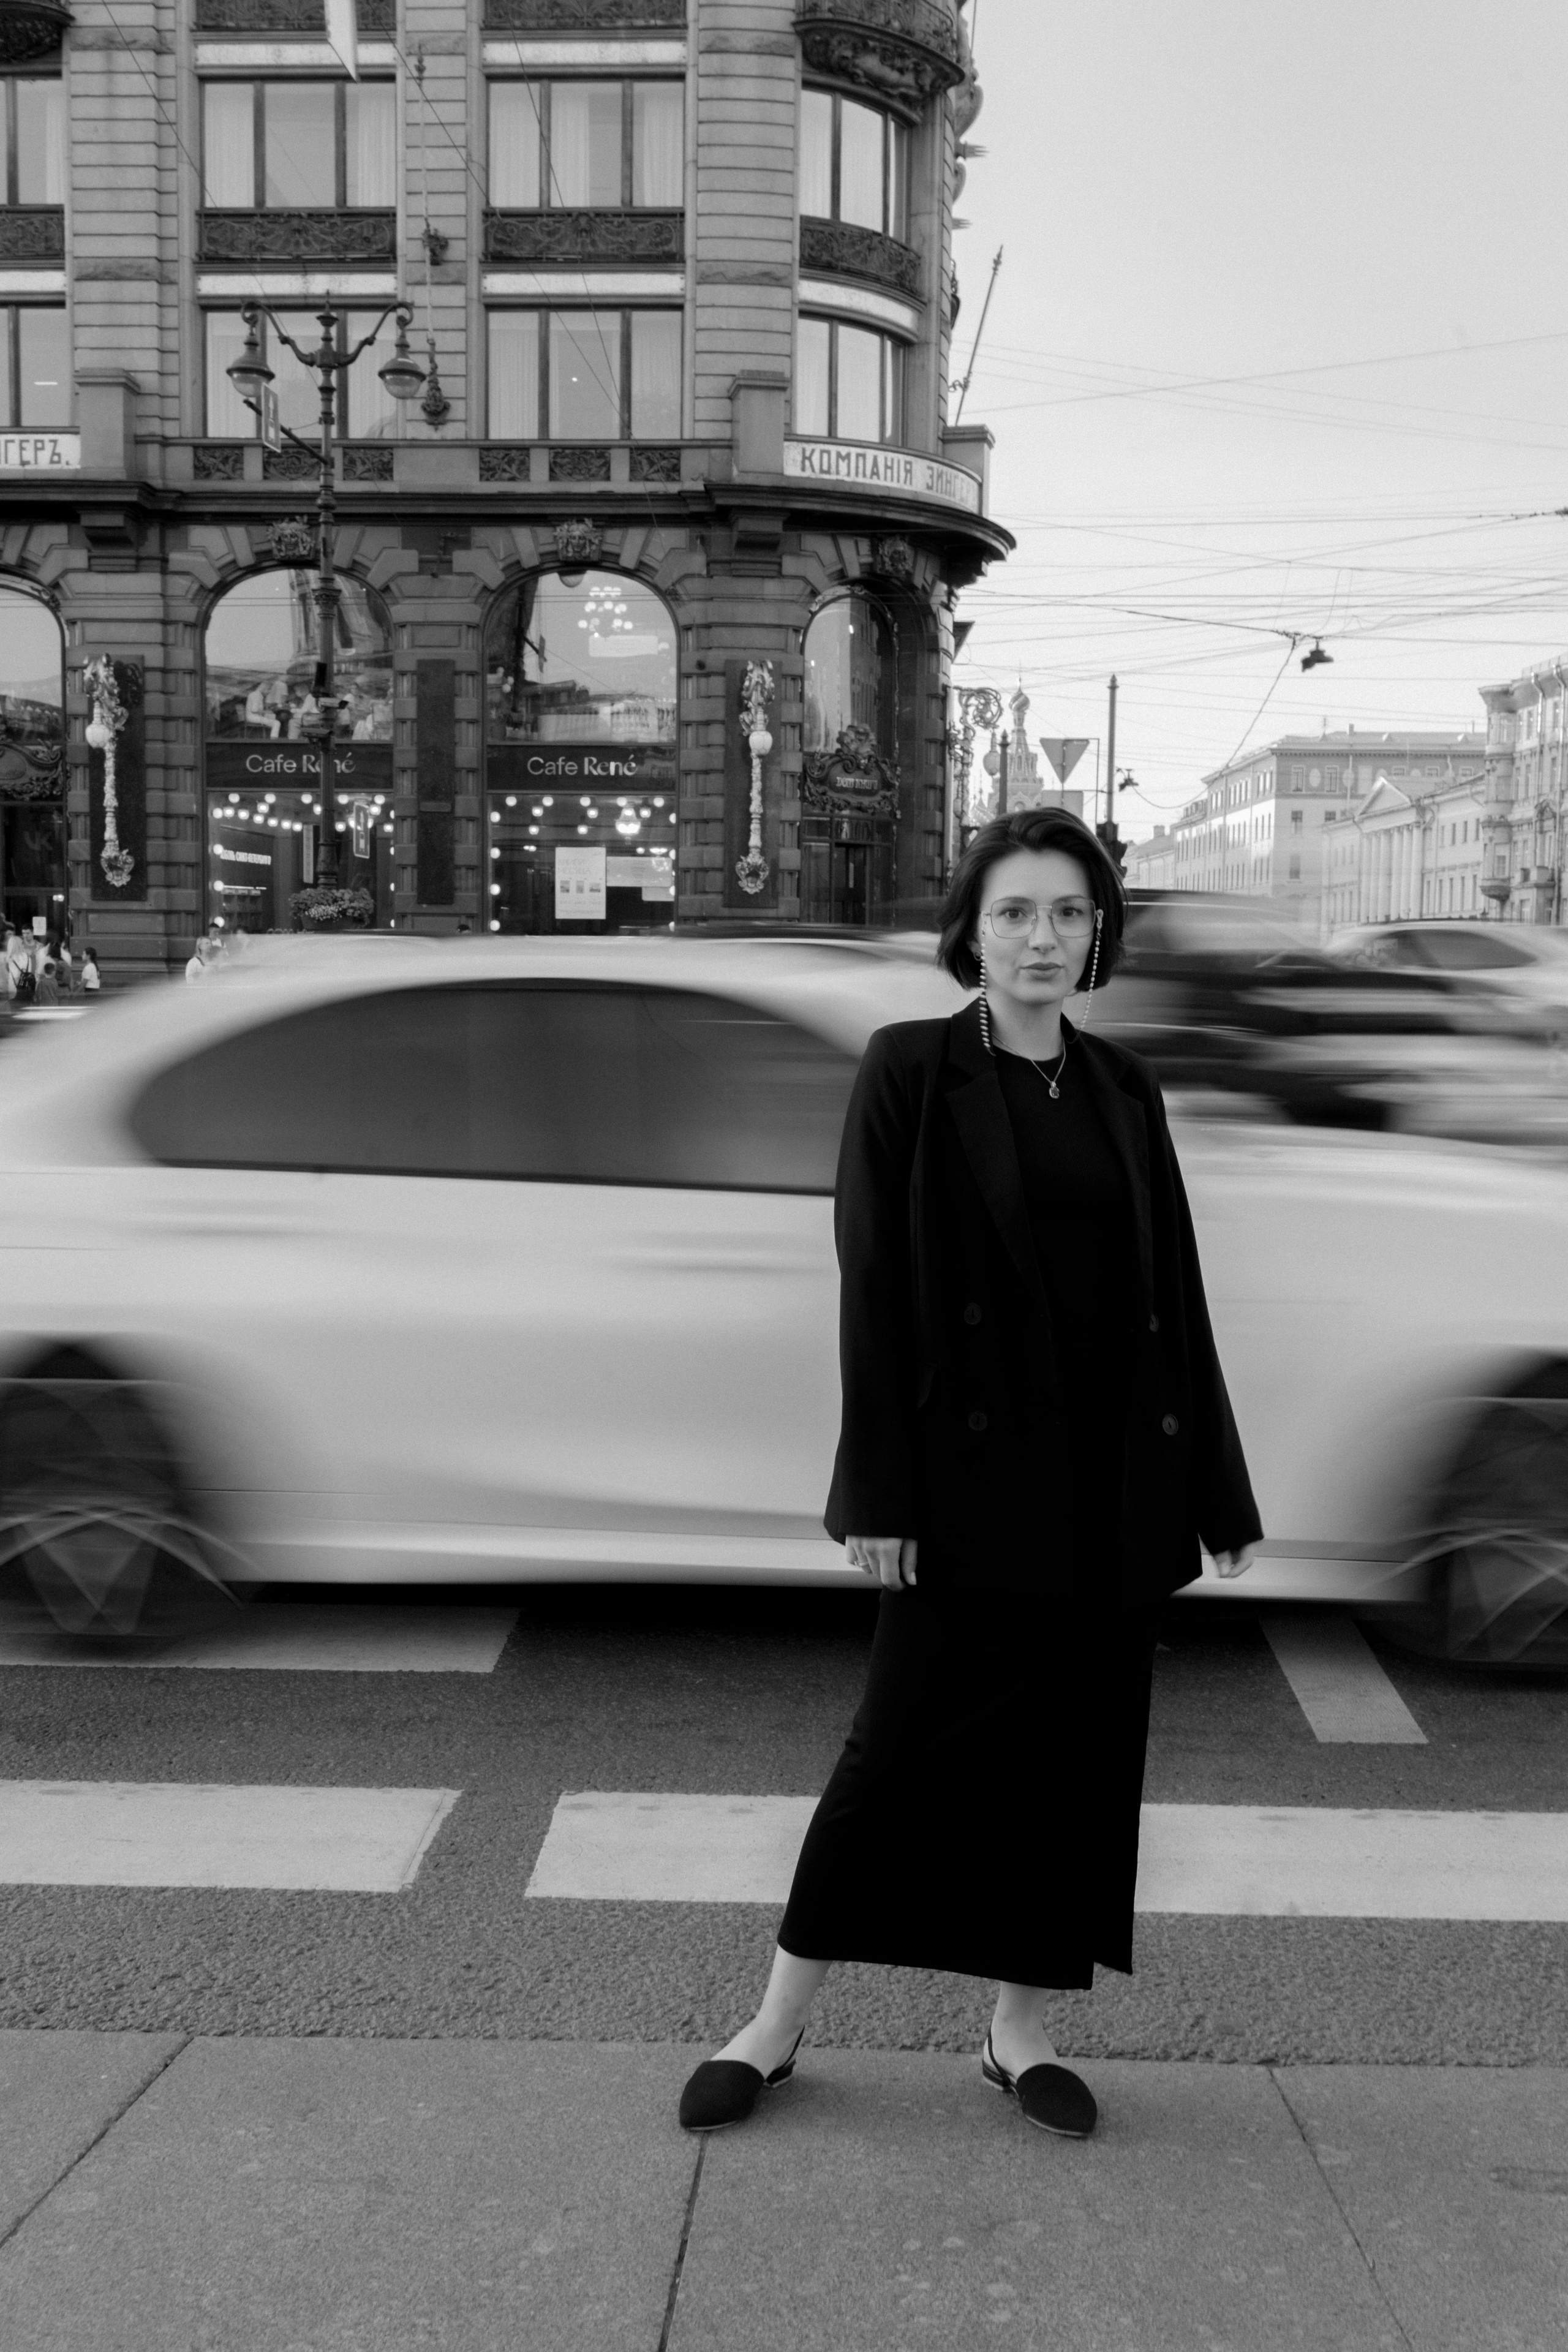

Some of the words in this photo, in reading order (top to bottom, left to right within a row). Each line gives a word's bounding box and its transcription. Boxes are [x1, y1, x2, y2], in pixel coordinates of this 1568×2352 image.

[0, 439, 69, 466] ГЕРЪ.
[801, 447, 913, 486] КОМПАНІЯ
[246, 753, 297, 773] Cafe
[527, 756, 578, 775] Cafe
[584, 753, 638, 776] René
